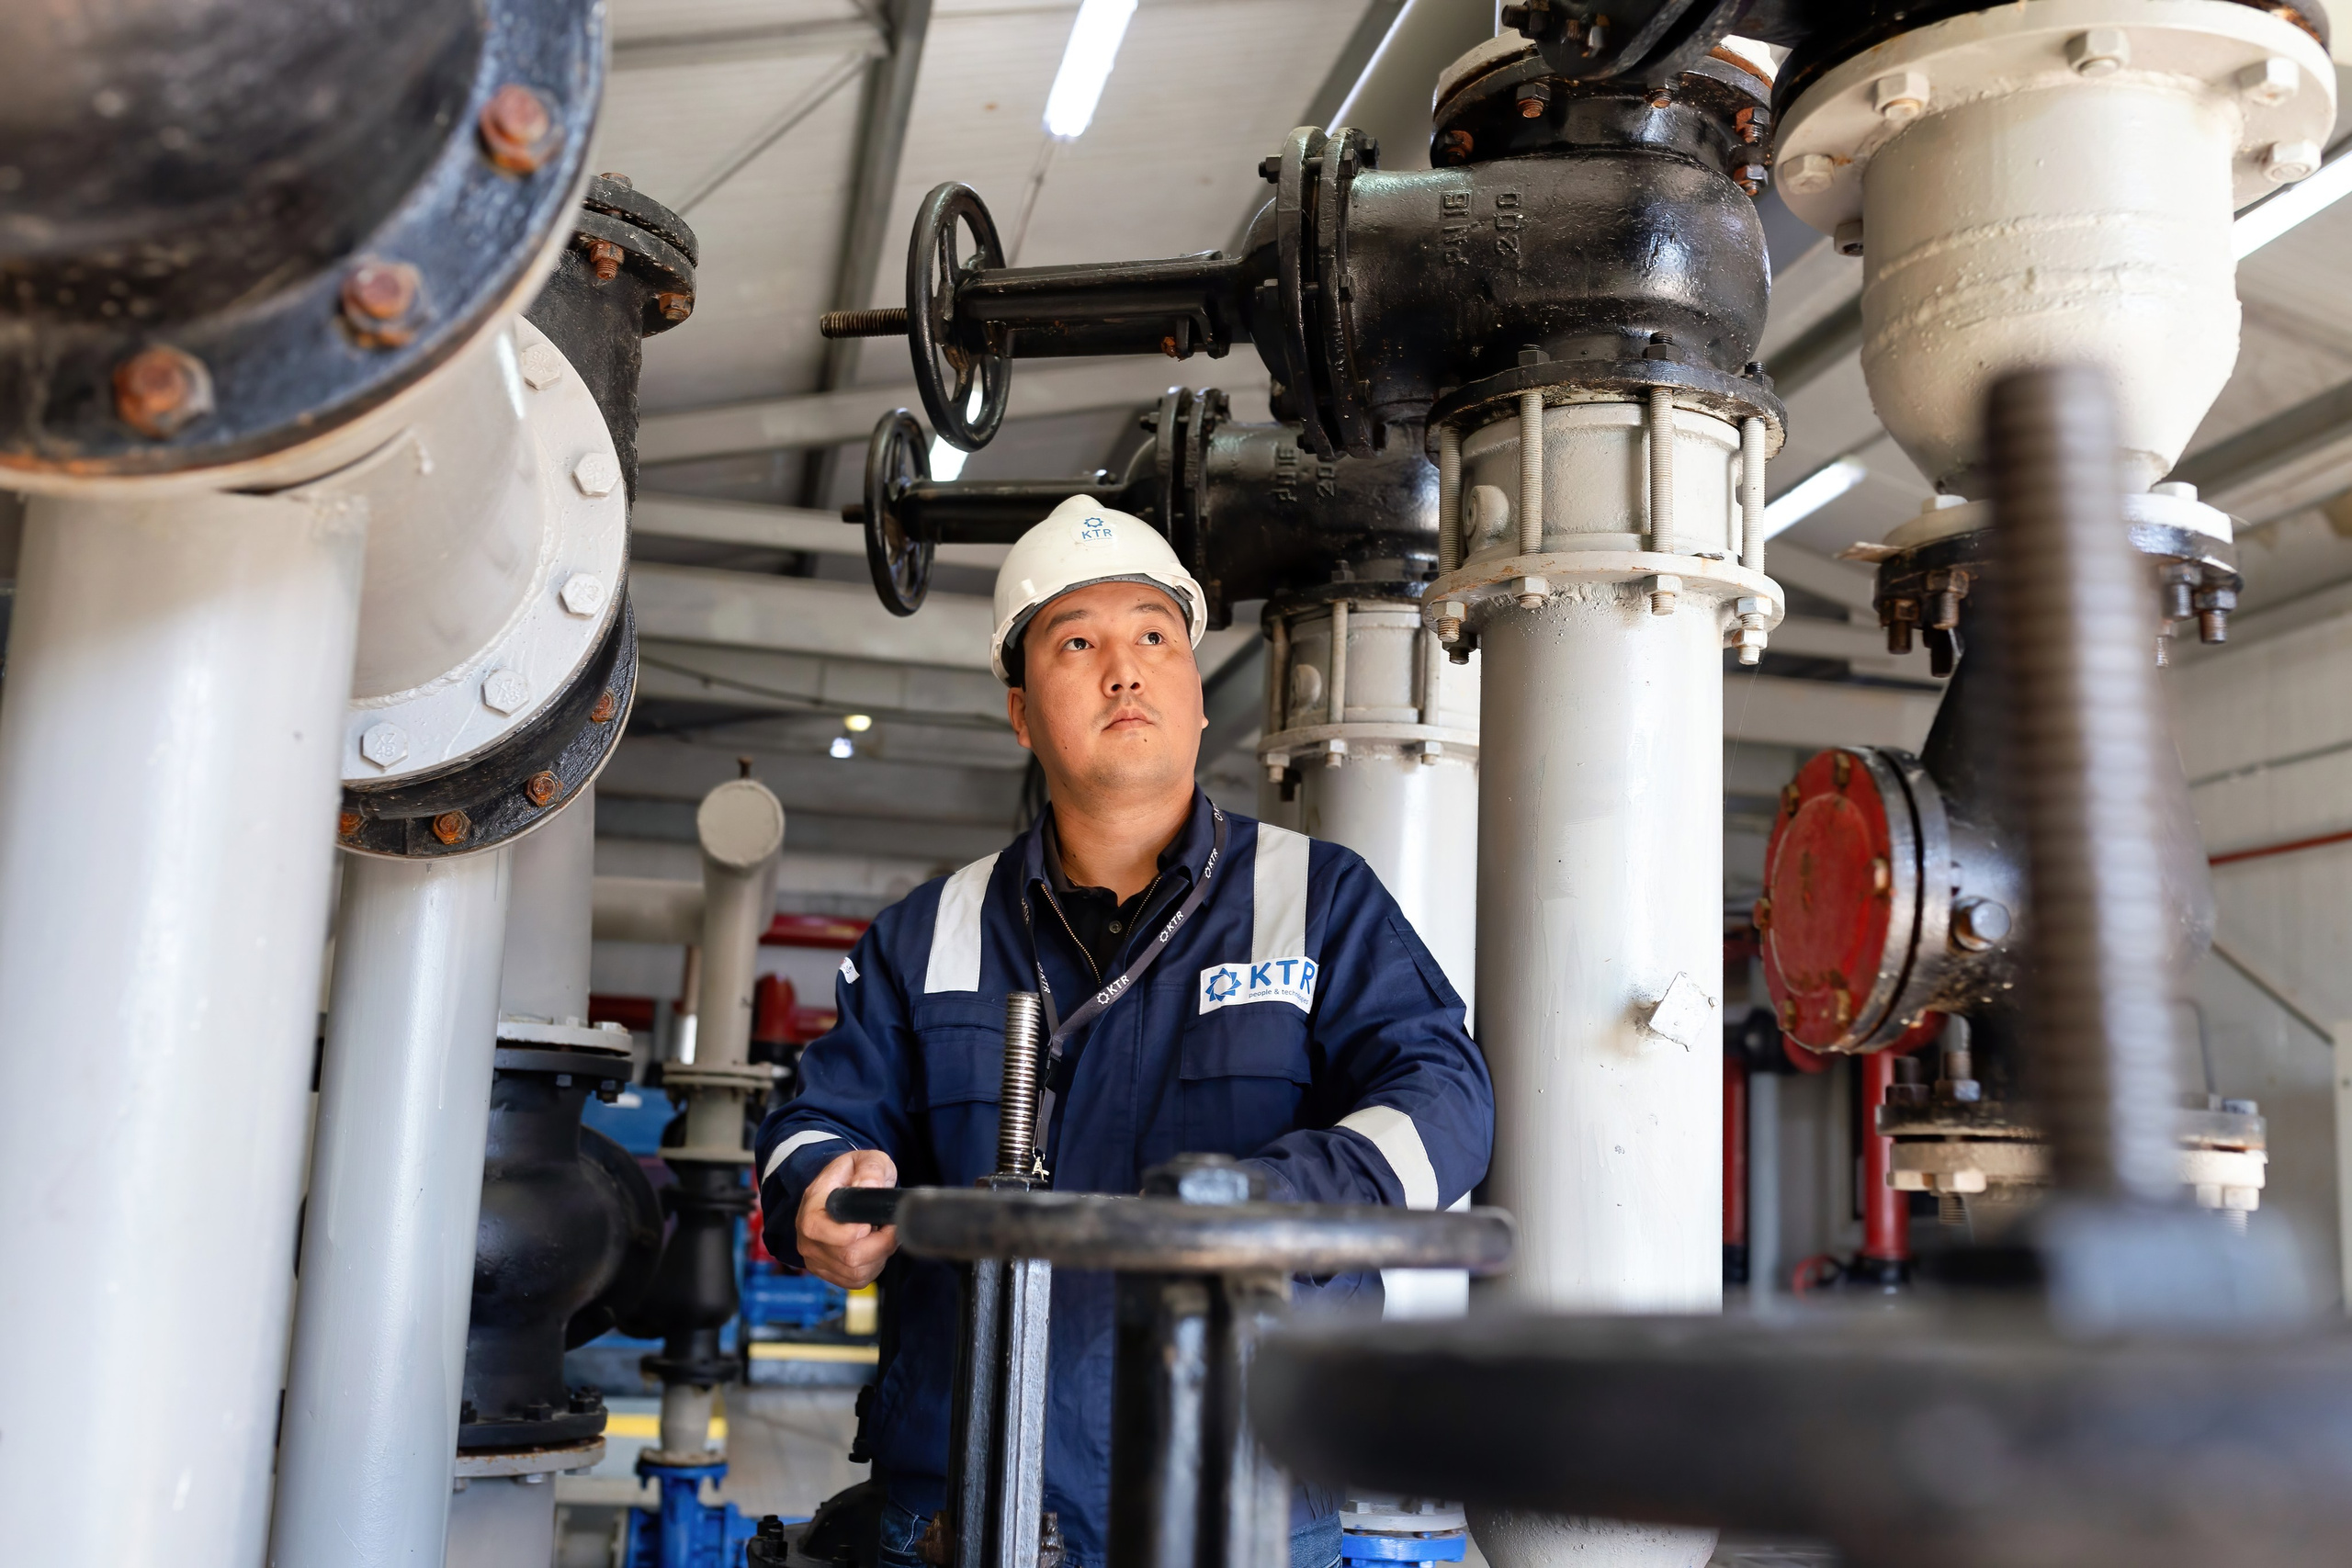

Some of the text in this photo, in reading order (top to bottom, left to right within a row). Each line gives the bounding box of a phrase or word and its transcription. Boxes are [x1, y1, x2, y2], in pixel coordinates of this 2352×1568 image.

[1495, 192, 1522, 257] 200
[1317, 465, 1335, 497] 20
[1081, 528, 1113, 540] KTR
[1208, 848, 1218, 869] KTR
[1166, 910, 1184, 931] KTR
[1040, 972, 1051, 994] KTR
[1106, 975, 1130, 996] KTR
[1250, 959, 1316, 995] KTR
[1249, 989, 1272, 998] people
